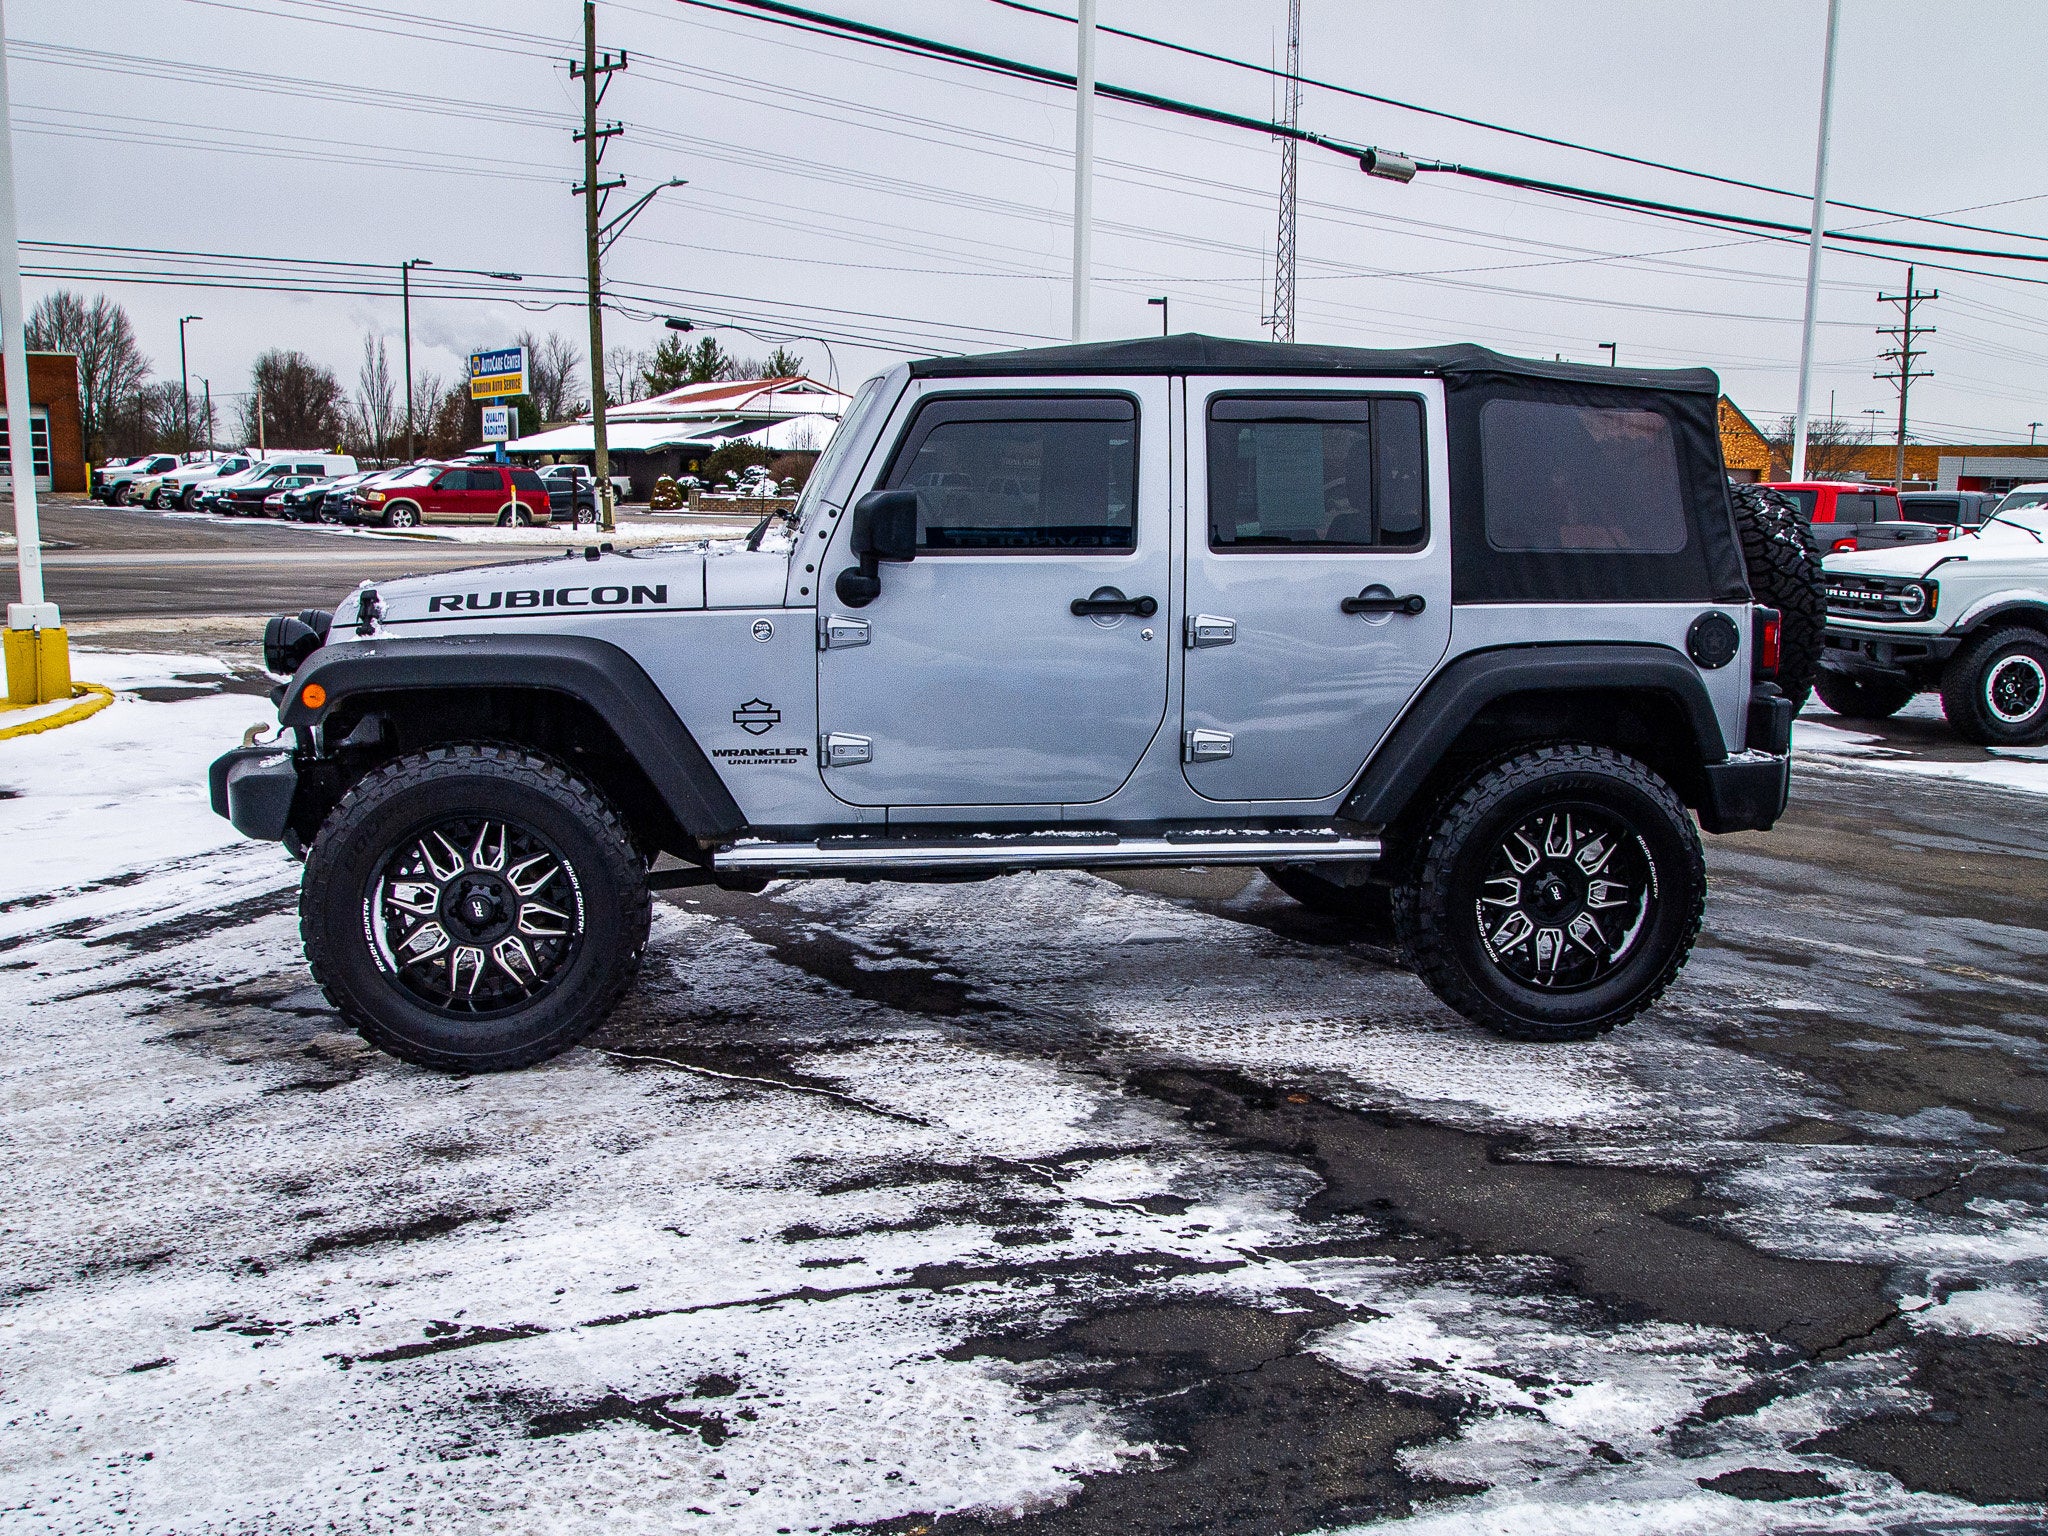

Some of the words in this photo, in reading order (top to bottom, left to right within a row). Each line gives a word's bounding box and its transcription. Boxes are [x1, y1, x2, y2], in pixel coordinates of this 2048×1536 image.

[492, 380, 503, 392] AUTO
[504, 378, 521, 391] SERVICE
[485, 412, 505, 423] QUALITY
[484, 424, 508, 436] RADIATOR
[428, 585, 667, 612] RUBICON
[1825, 588, 1882, 600] RONCO
[712, 748, 809, 757] WRANGLER
[1649, 861, 1658, 899] COUNTRY
[563, 859, 580, 889] ROUGH
[575, 891, 584, 934] COUNTRY
[1550, 886, 1562, 900] RC
[472, 901, 484, 917] RC
[363, 897, 373, 941] COUNTRY
[1475, 898, 1486, 937] COUNTRY
[368, 942, 387, 973] ROUGH
